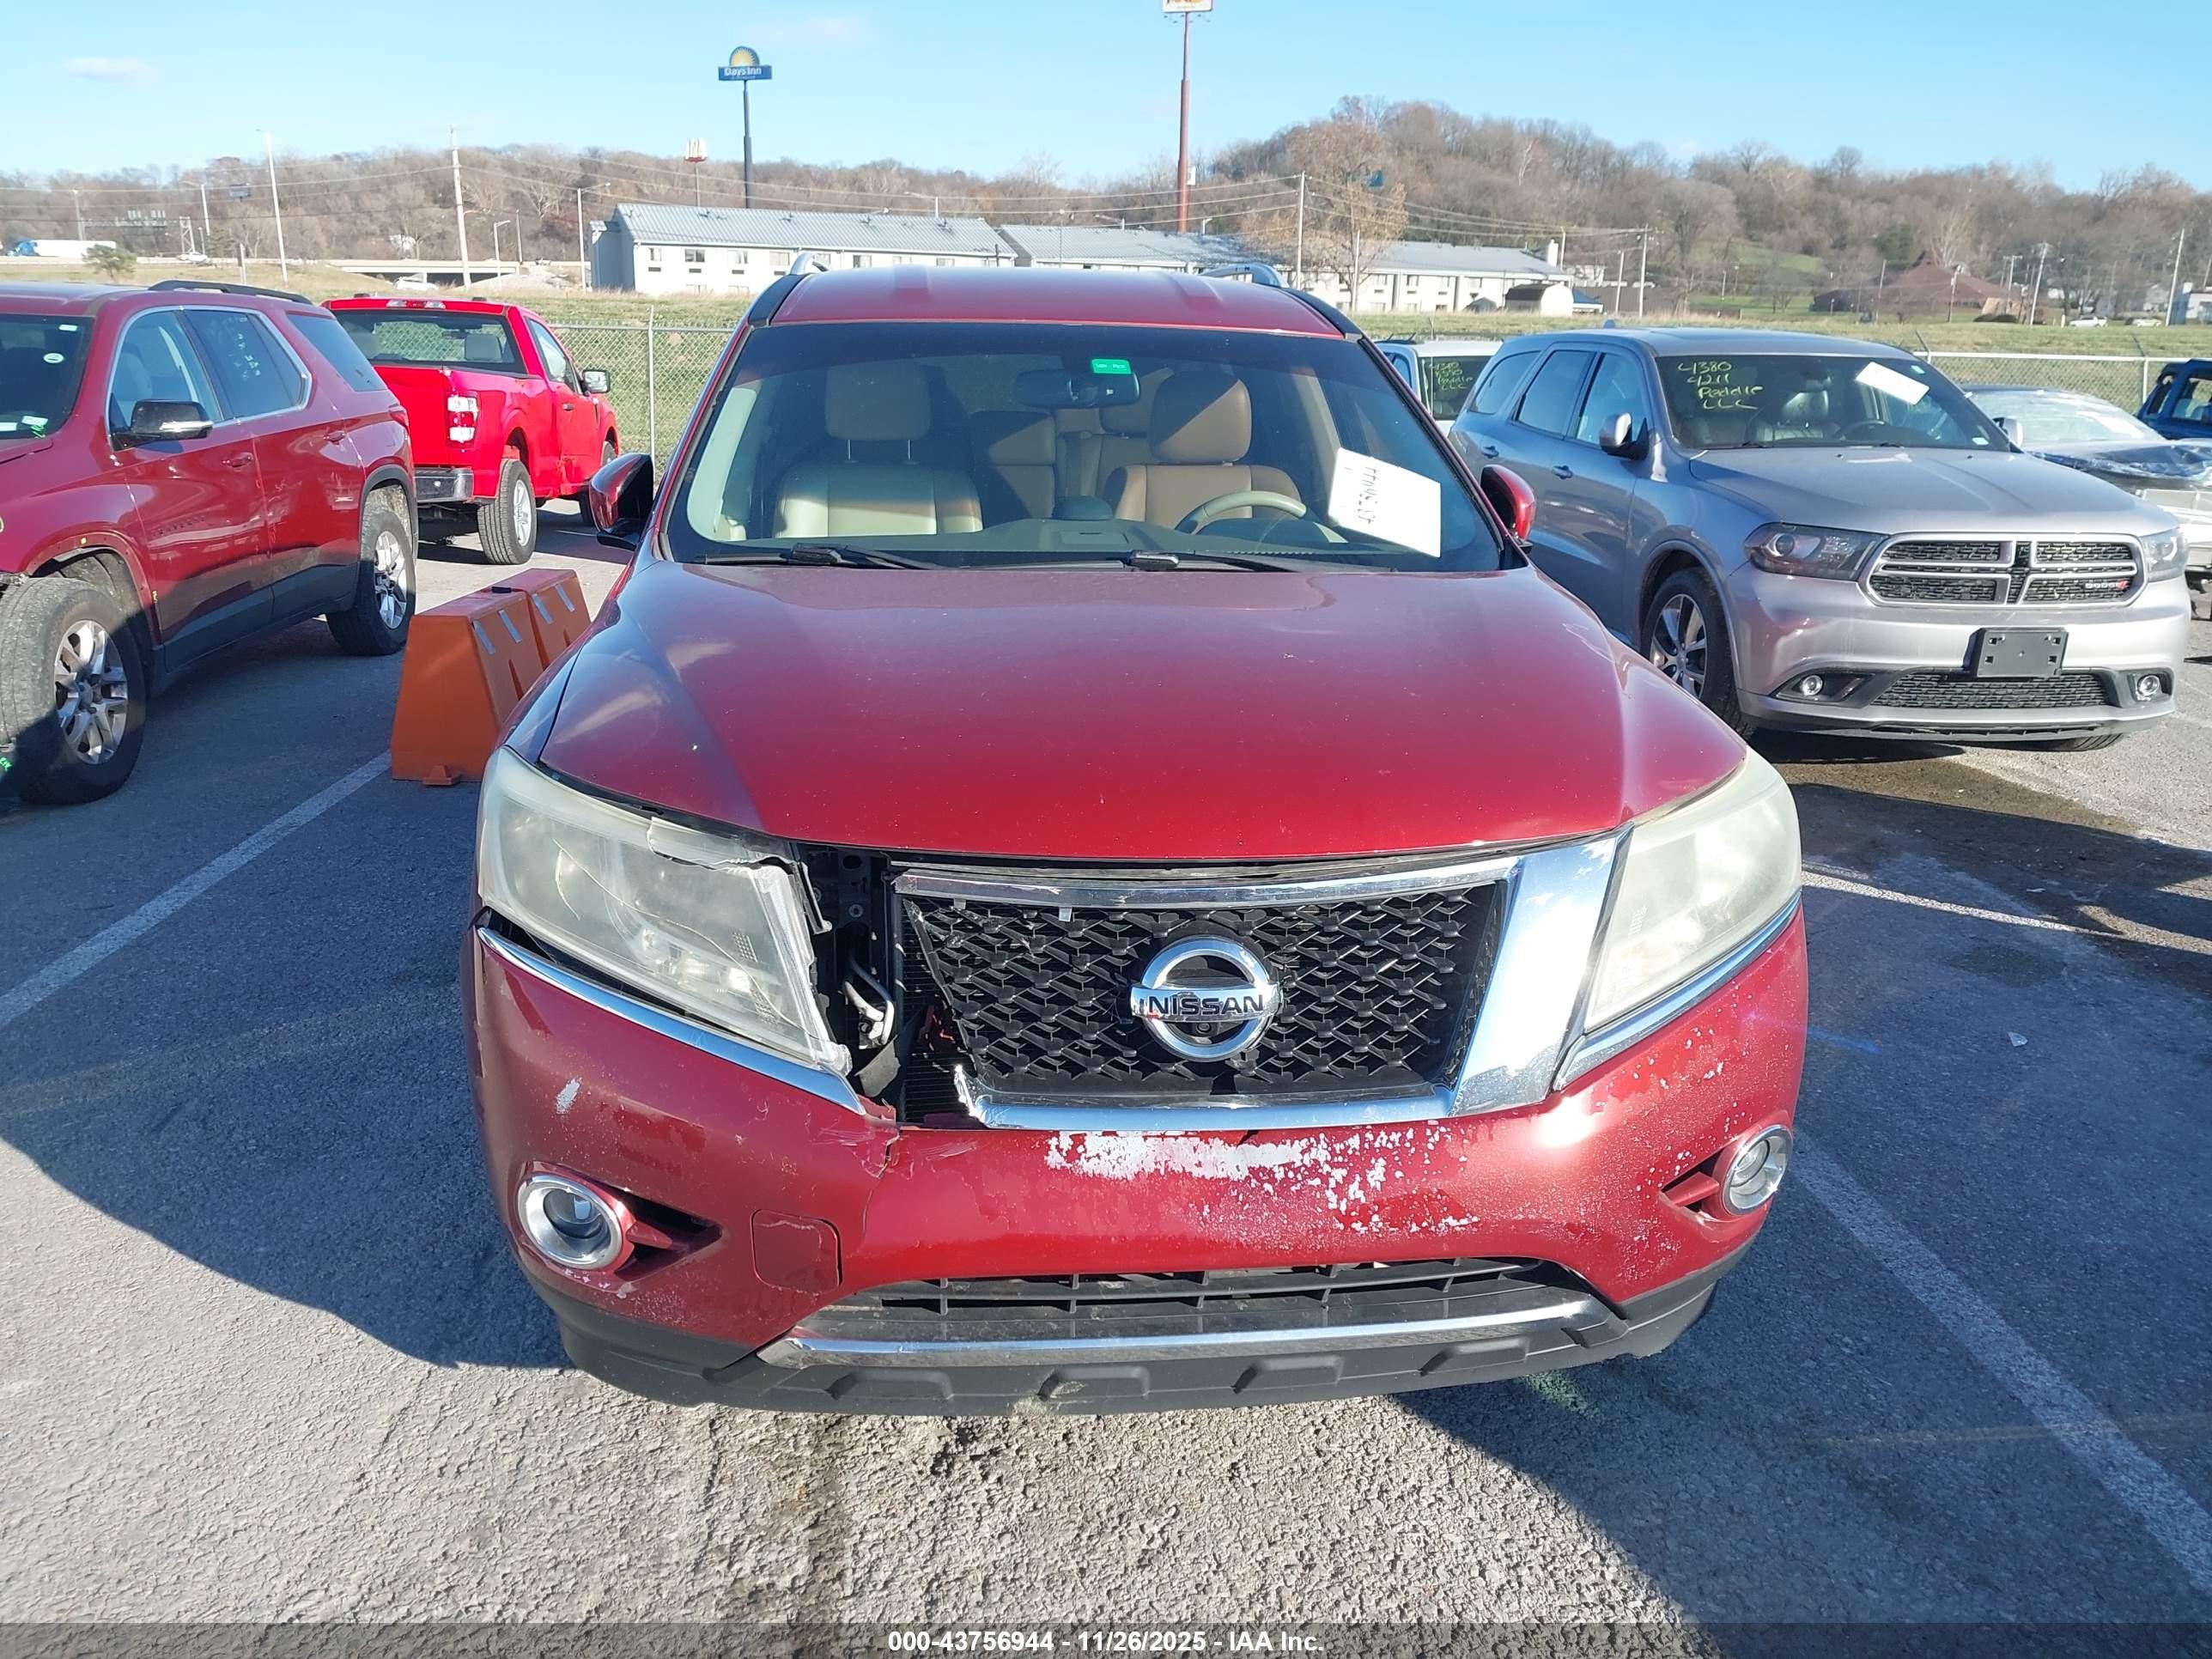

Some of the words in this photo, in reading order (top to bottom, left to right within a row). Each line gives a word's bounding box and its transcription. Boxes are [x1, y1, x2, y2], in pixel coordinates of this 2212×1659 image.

[724, 68, 746, 76] Days
[1703, 398, 1759, 410] LLC
[1149, 994, 1263, 1015] NISSAN
